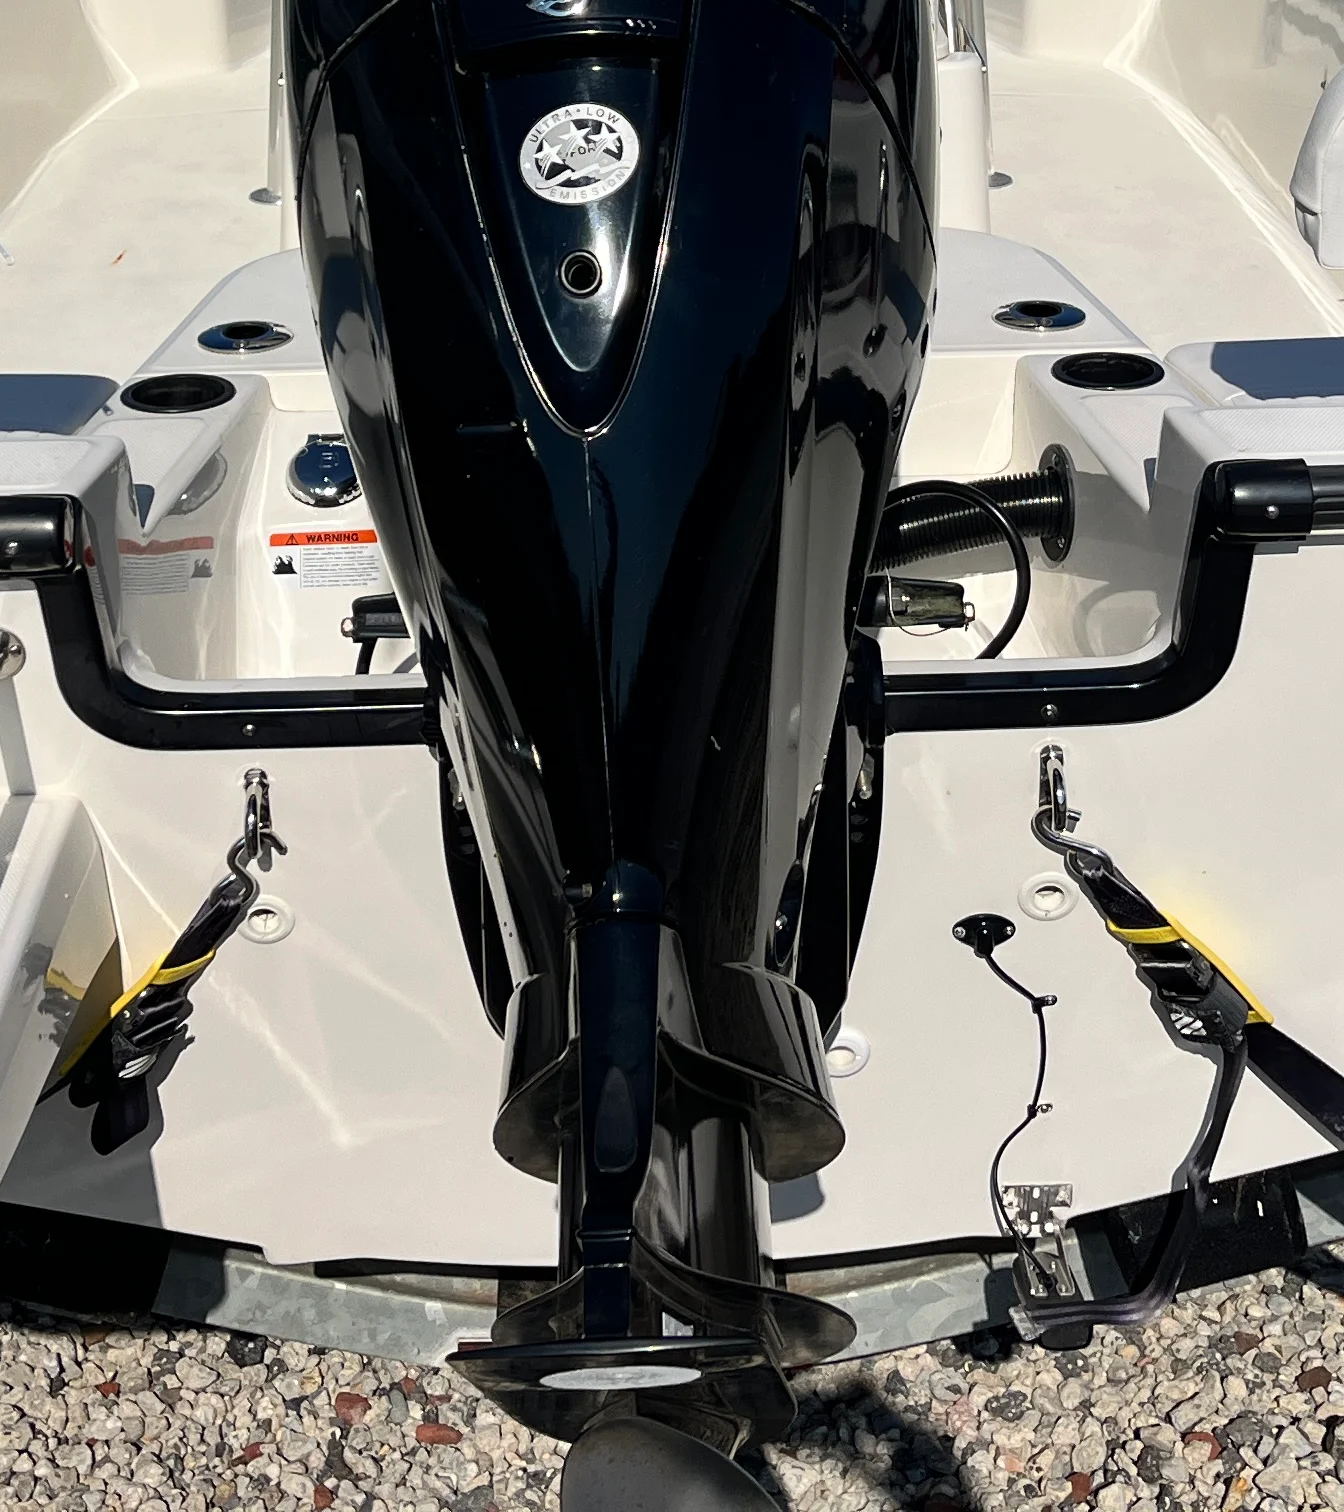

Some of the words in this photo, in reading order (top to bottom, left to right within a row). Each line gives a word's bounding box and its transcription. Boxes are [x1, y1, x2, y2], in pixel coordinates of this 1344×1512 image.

[529, 108, 574, 144] ULTRA
[585, 105, 621, 125] LOW
[548, 169, 627, 201] EMISSION
[305, 532, 360, 543] WARNING
